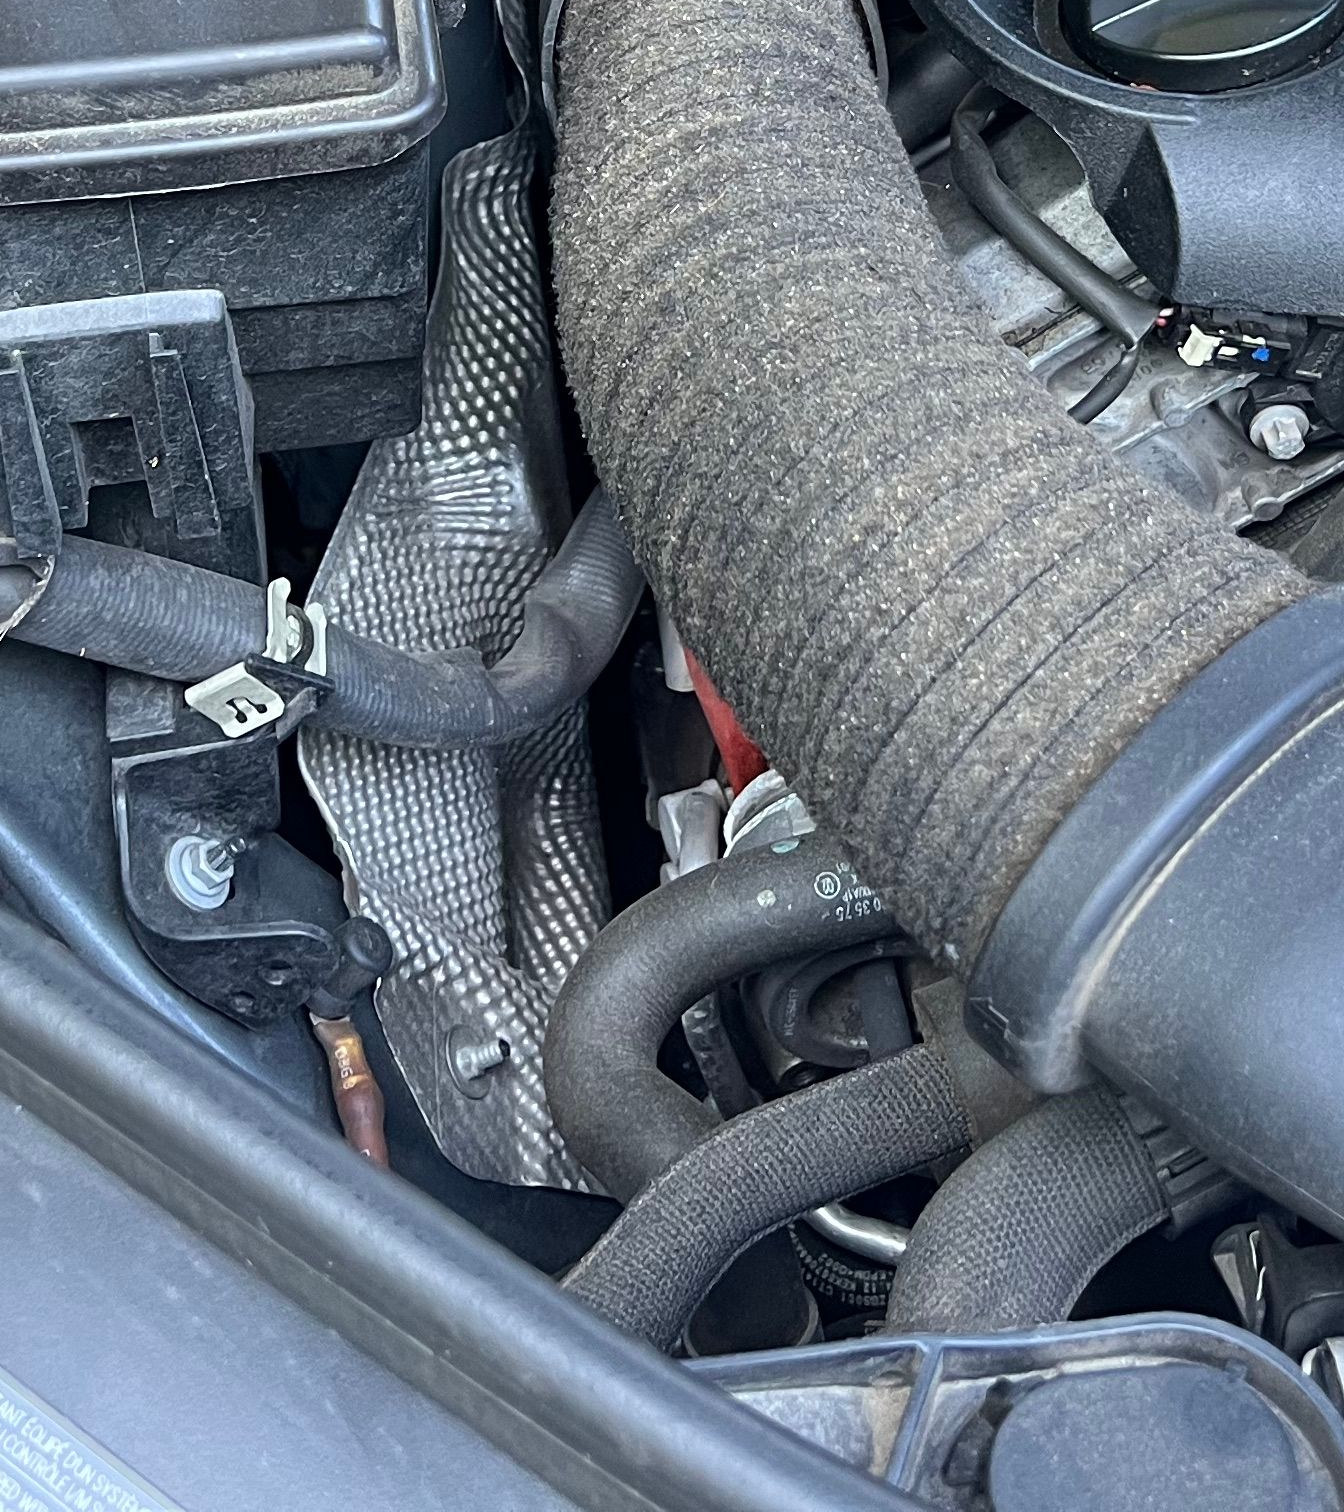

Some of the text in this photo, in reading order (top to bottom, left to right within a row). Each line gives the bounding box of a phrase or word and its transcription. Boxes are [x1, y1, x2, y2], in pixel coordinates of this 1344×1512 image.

[3, 1434, 72, 1492] CONTRÔLE
[21, 1416, 72, 1461] ÉQUIPÉ
[92, 1474, 153, 1512] SYSTÈ
